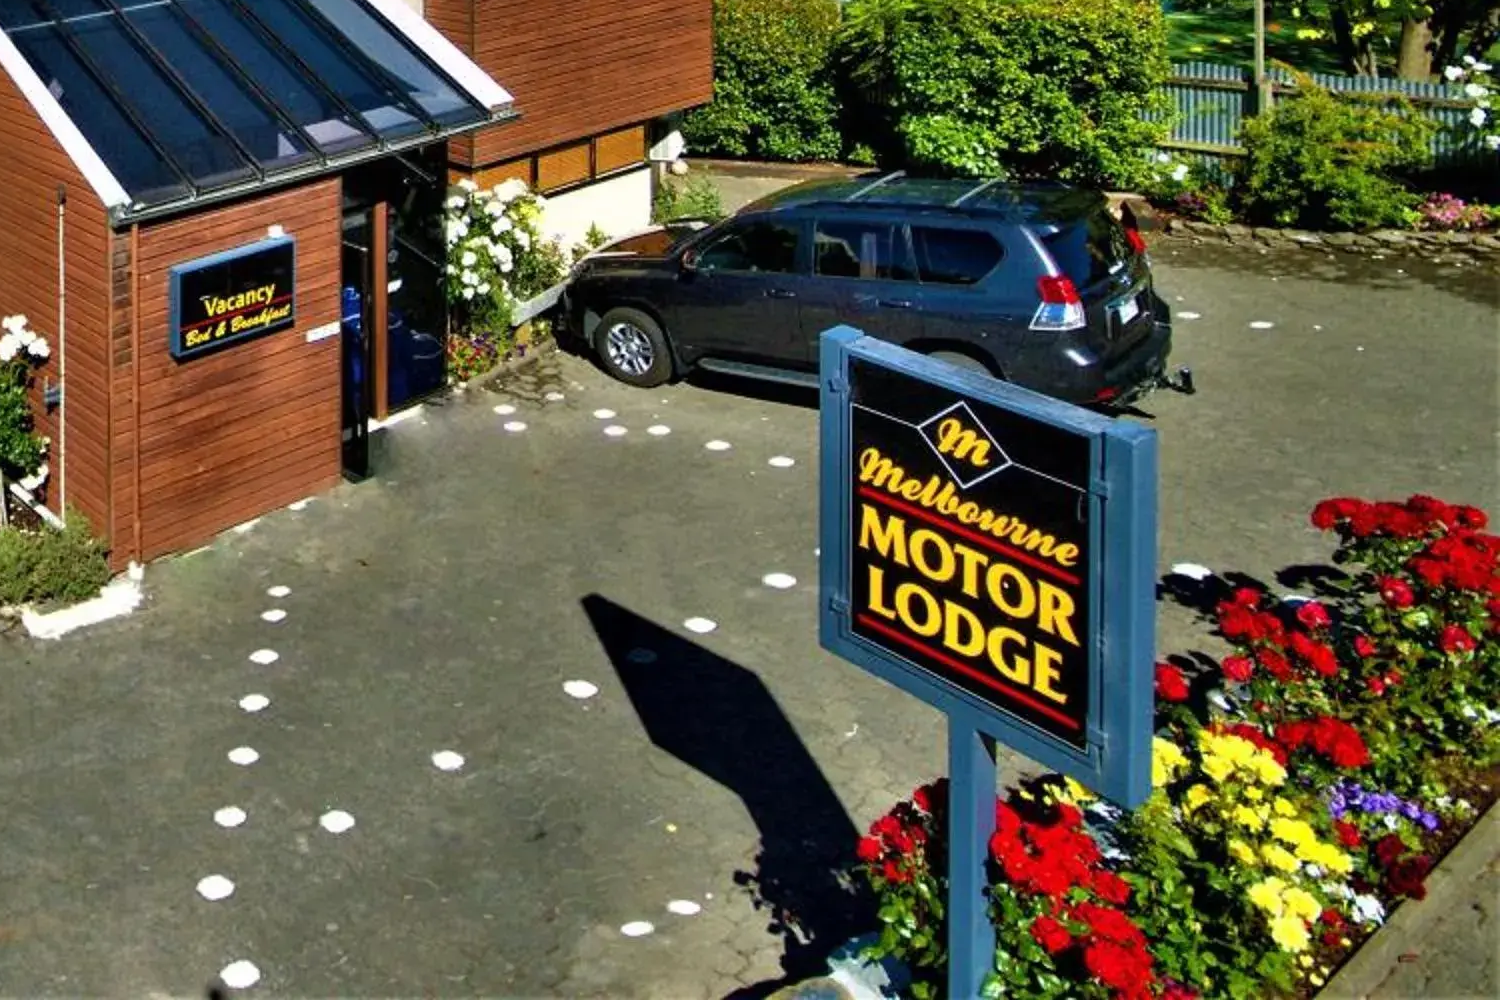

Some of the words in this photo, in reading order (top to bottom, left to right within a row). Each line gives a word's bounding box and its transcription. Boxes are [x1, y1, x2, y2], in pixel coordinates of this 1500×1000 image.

[185, 326, 212, 348] Bed
[214, 321, 227, 338] &
[230, 303, 291, 333] Breakfast
[203, 282, 276, 318] Vacancy
[859, 447, 1081, 568] Melbourne
[858, 502, 1082, 648] MOTOR
[867, 565, 1068, 704] LODGE
